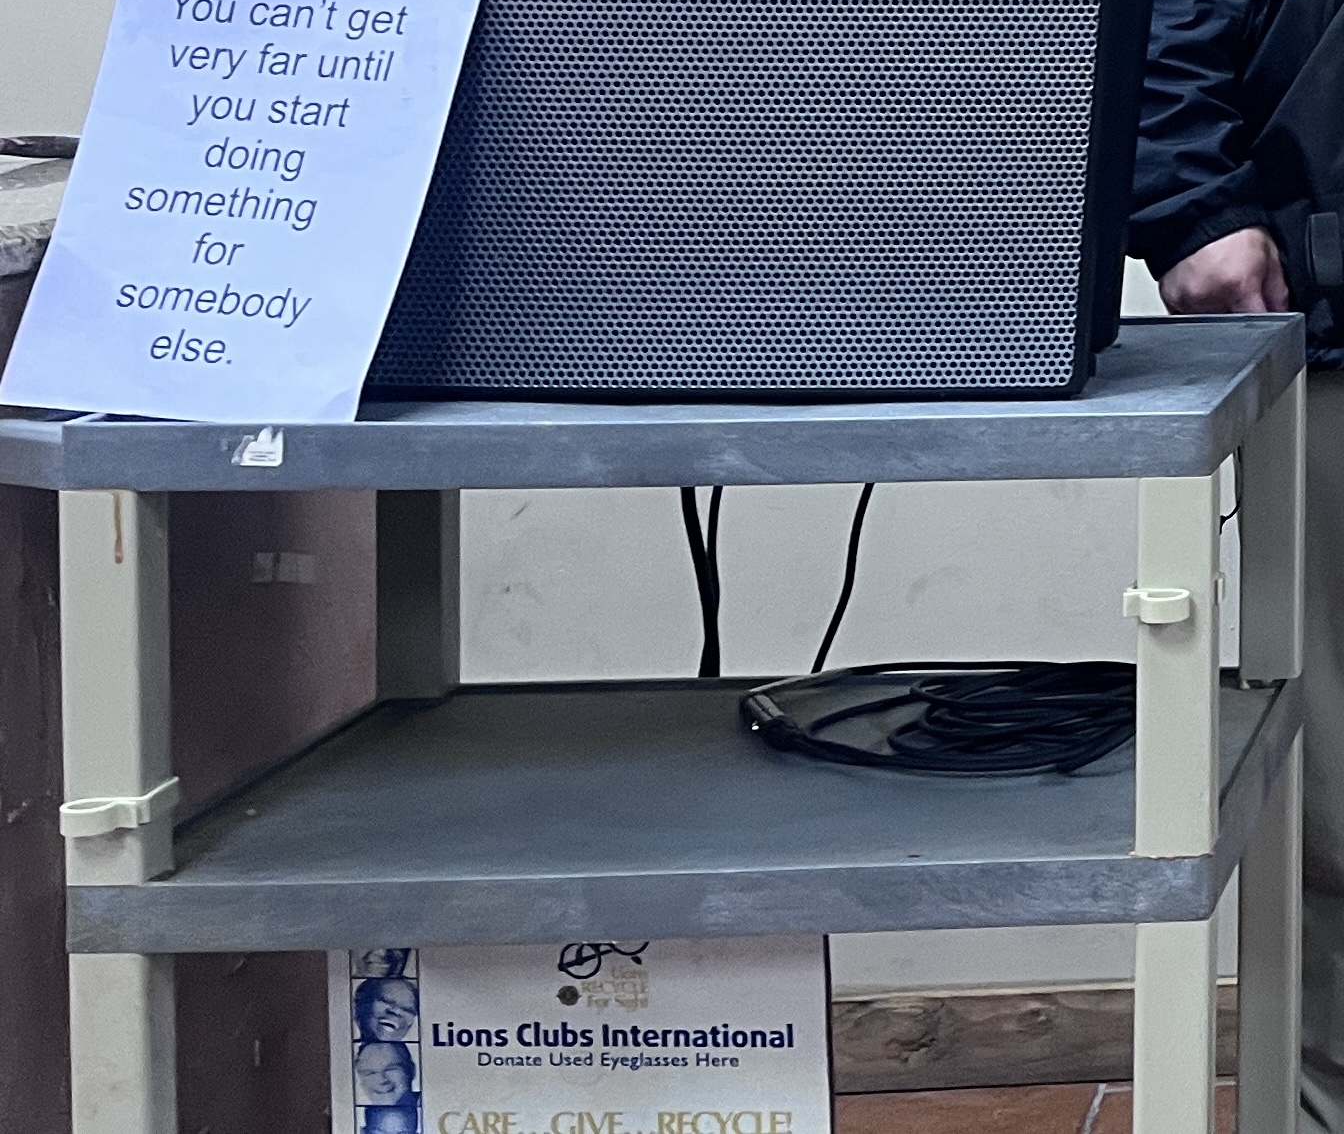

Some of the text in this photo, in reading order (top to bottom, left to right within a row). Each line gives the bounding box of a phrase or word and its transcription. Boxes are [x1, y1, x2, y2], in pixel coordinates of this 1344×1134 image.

[249, 0, 339, 31] can't
[346, 6, 408, 39] get
[170, 43, 394, 82] very far until
[187, 94, 350, 128] you start
[204, 137, 306, 182] doing
[124, 185, 318, 231] something
[192, 233, 245, 266] for
[116, 282, 312, 328] somebody
[149, 330, 232, 364] else.
[432, 1022, 794, 1050] Lions Clubs International
[477, 1052, 740, 1072] Donate Used Eyeglasses Here
